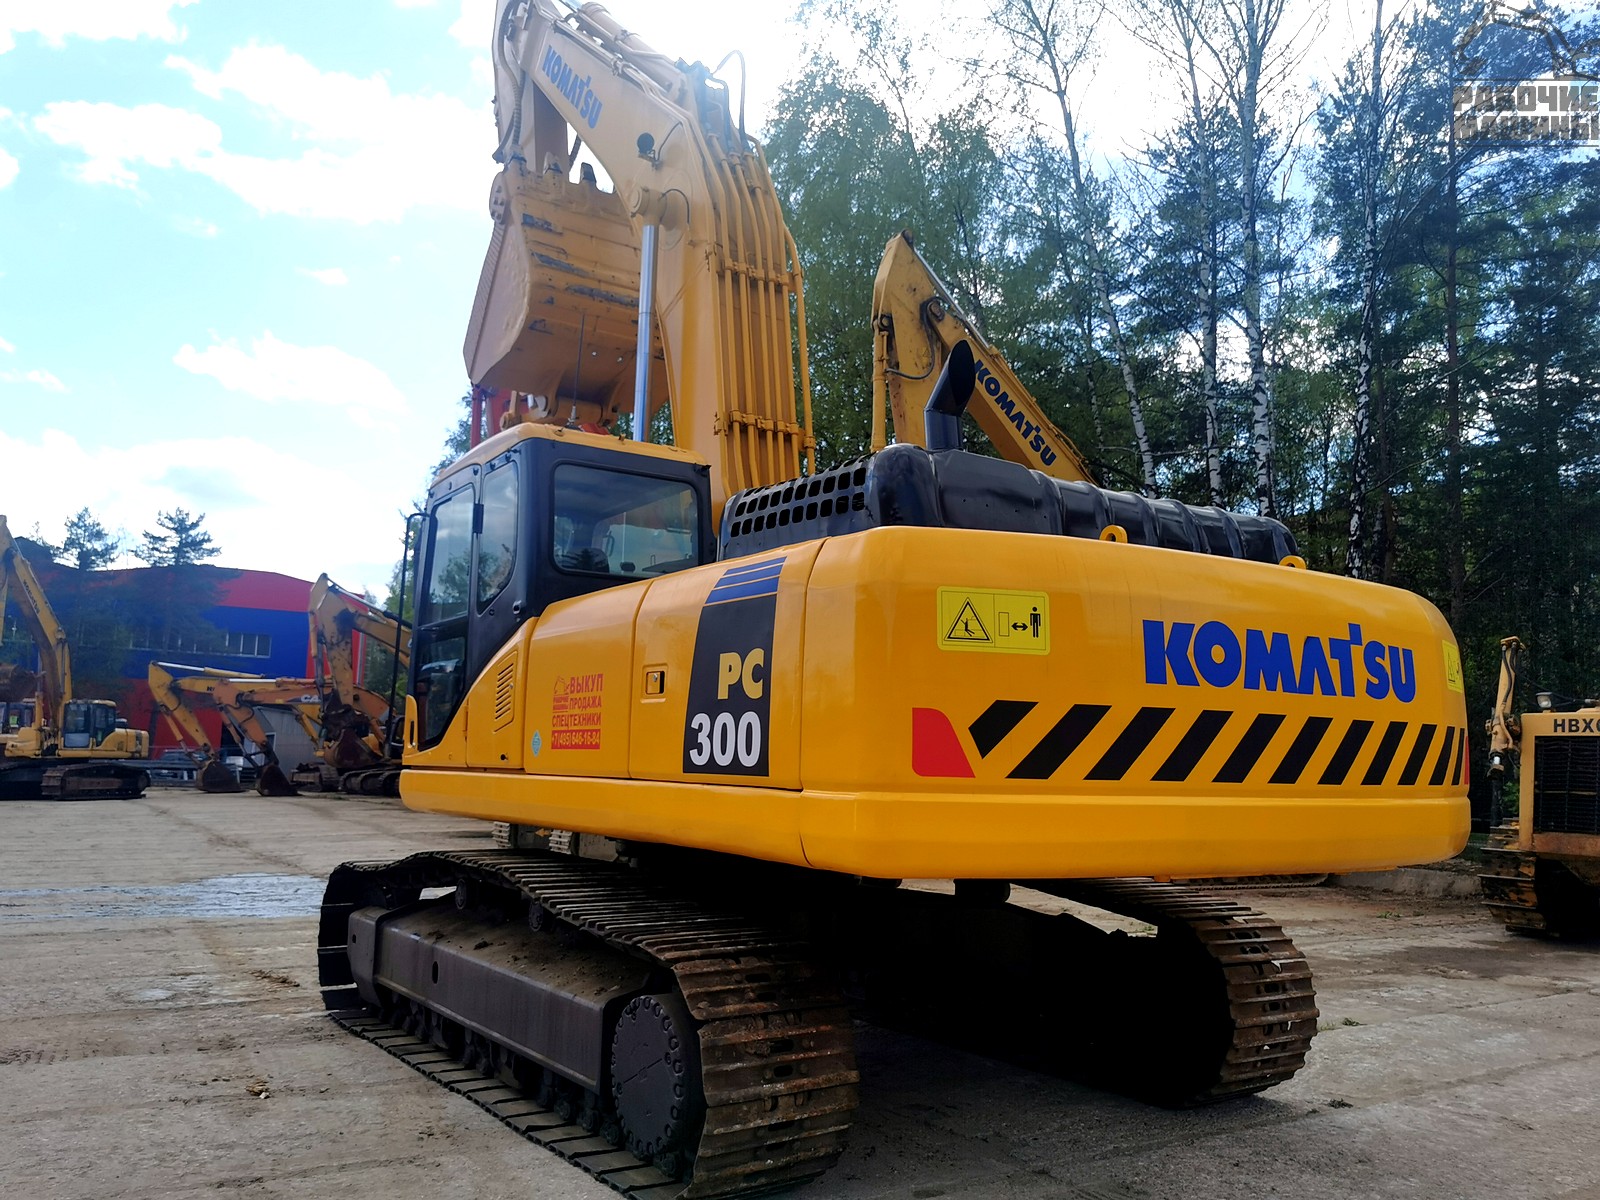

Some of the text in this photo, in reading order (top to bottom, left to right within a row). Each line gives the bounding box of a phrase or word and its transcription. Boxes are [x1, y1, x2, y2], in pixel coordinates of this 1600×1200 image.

[542, 44, 603, 129] KOMATSU
[974, 359, 1057, 466] KOMATSU
[569, 673, 604, 694] ВЫКУП
[717, 647, 765, 700] PC
[1142, 619, 1416, 704] KOMATSU
[552, 712, 602, 730] СПЕЦТЕХНИКИ
[569, 695, 602, 712] ПРОДАЖА
[1553, 718, 1600, 733] HBX
[689, 710, 762, 768] 300
